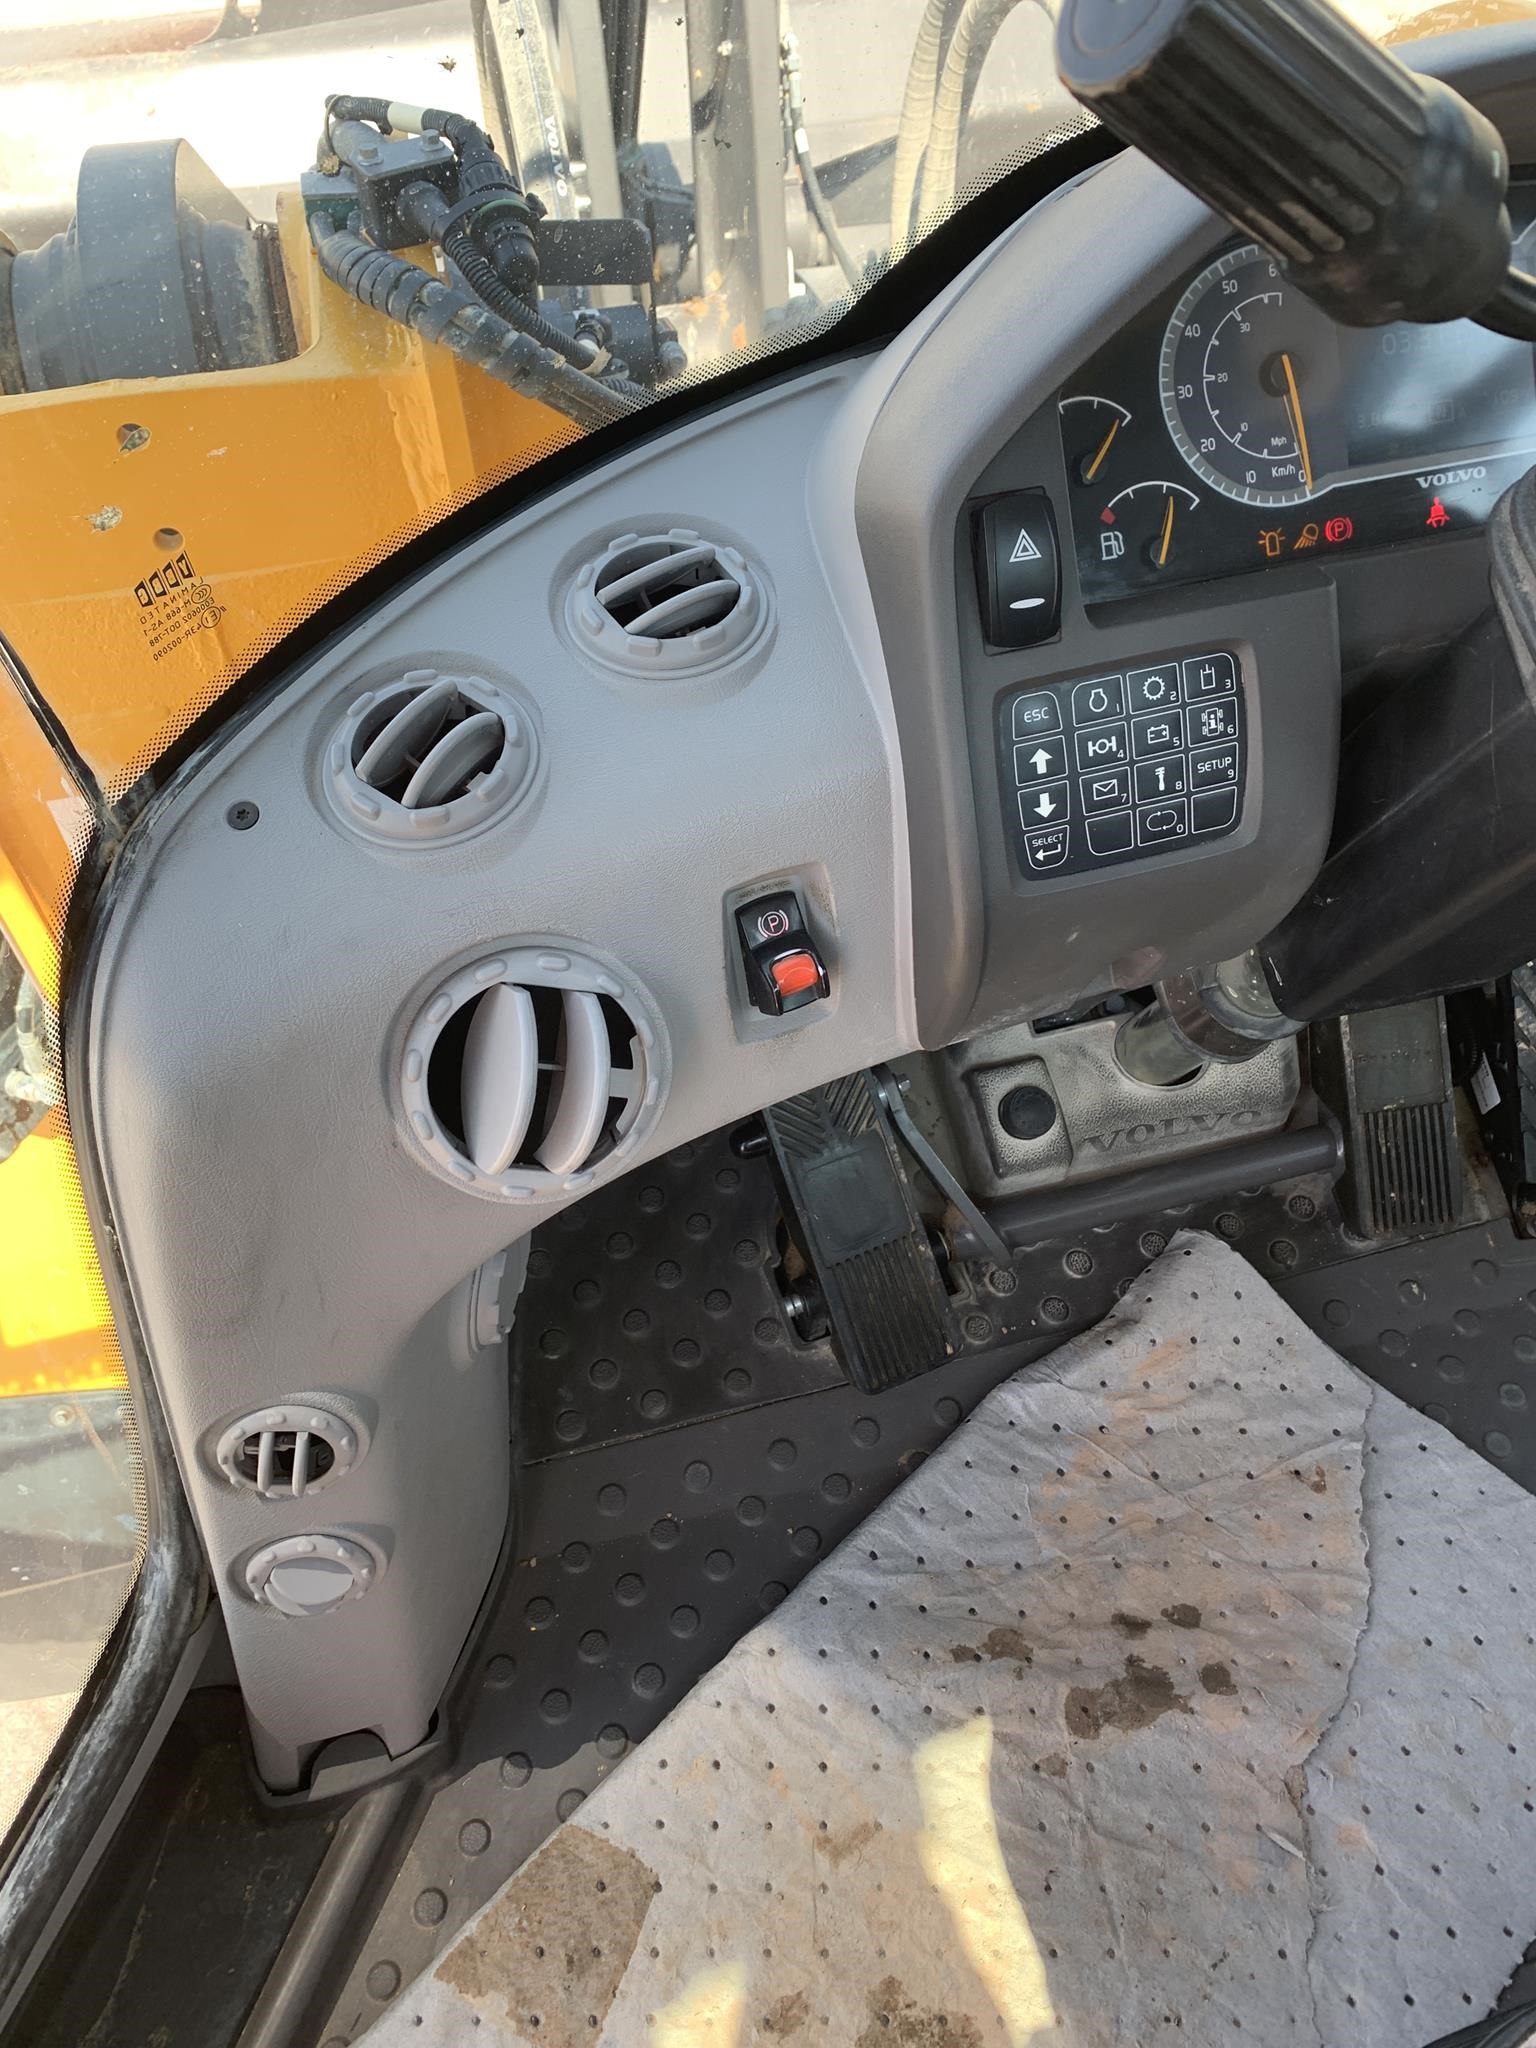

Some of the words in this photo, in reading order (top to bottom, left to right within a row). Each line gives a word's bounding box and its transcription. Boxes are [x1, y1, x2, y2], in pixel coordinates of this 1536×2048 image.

[544, 115, 568, 197] VOLVO
[1222, 279, 1238, 294] 50
[1184, 323, 1200, 338] 40
[1239, 322, 1250, 333] 30
[1217, 372, 1228, 383] 20
[1177, 384, 1193, 399] 30
[1240, 422, 1248, 432] 10
[1200, 437, 1216, 453] 20
[1271, 436, 1287, 447] Mph
[1245, 470, 1256, 484] 10
[1271, 464, 1296, 478] Km/h
[1298, 469, 1307, 483] 0
[1415, 466, 1488, 489] VOLVO
[1224, 679, 1232, 689] 3
[1169, 691, 1177, 701] 2
[1024, 706, 1050, 723] ESC
[1227, 724, 1234, 734] 6
[1173, 737, 1180, 747] 5
[1117, 749, 1125, 759] 4
[1197, 756, 1232, 774] SETUP
[1227, 769, 1235, 779] 9
[1175, 781, 1182, 791] 8
[1120, 793, 1128, 803] 7
[1176, 823, 1184, 833] 0
[1031, 832, 1064, 848] SELECT
[1082, 1110, 1262, 1153] VOLVO
